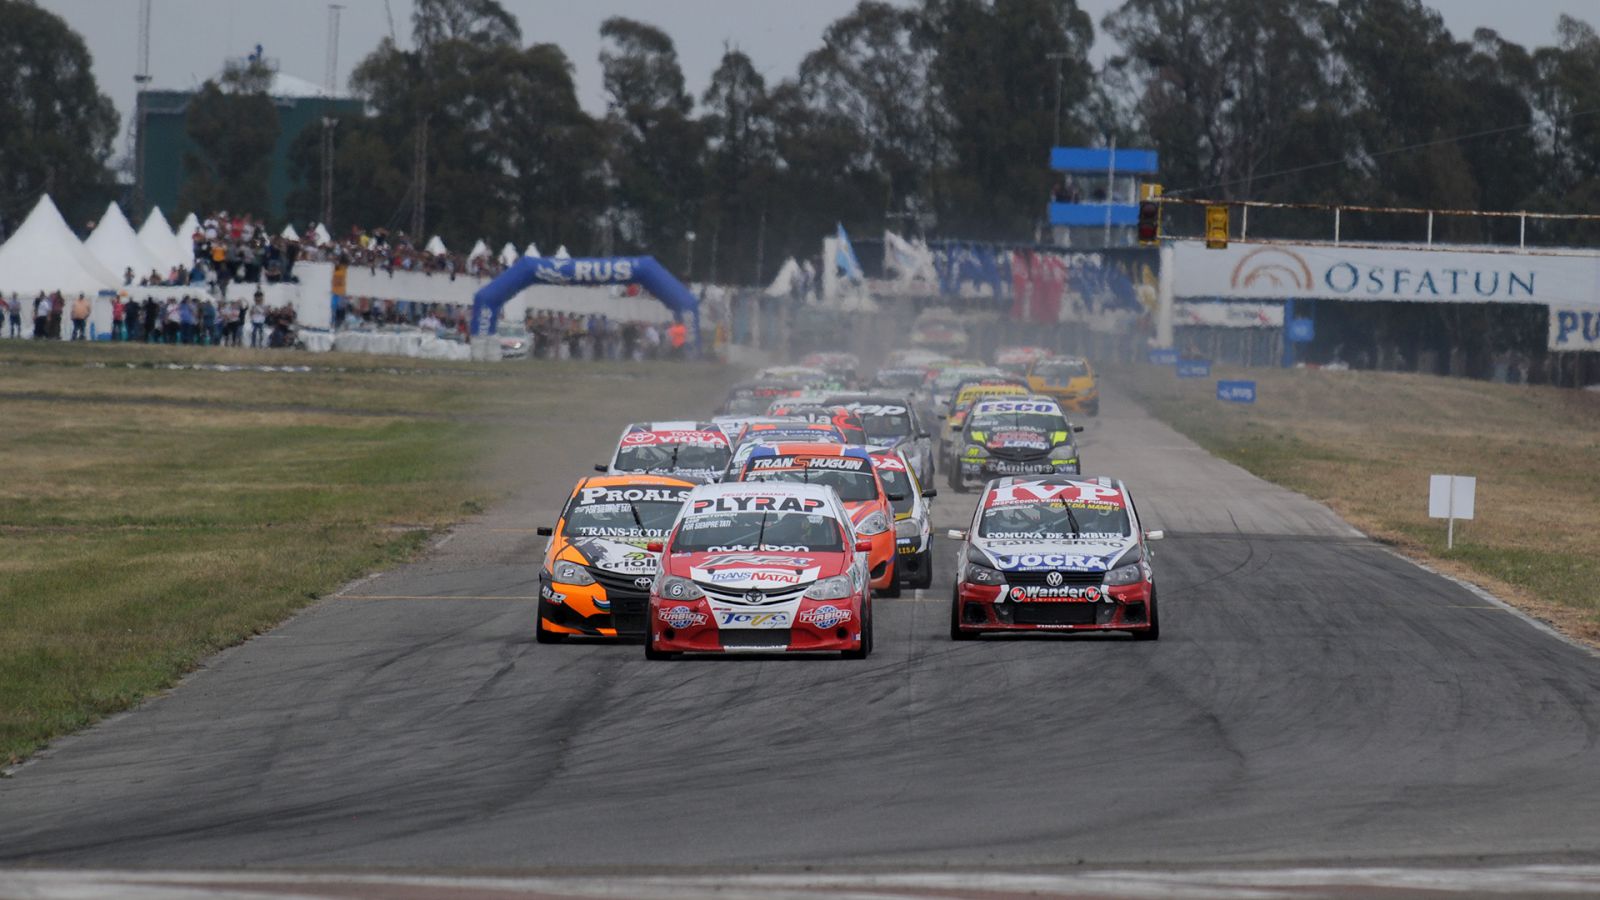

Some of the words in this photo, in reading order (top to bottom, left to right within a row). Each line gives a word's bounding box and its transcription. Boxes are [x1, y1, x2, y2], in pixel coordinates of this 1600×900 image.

[575, 261, 633, 281] RUS
[1324, 261, 1537, 297] OSFATUN
[980, 403, 1053, 413] ESCO
[991, 480, 1120, 501] IVP
[693, 496, 826, 514] PLYRAP
[998, 554, 1108, 569] JOCRA
[563, 568, 575, 577] 2
[672, 584, 683, 595] 6
[1026, 586, 1086, 599] Wander
